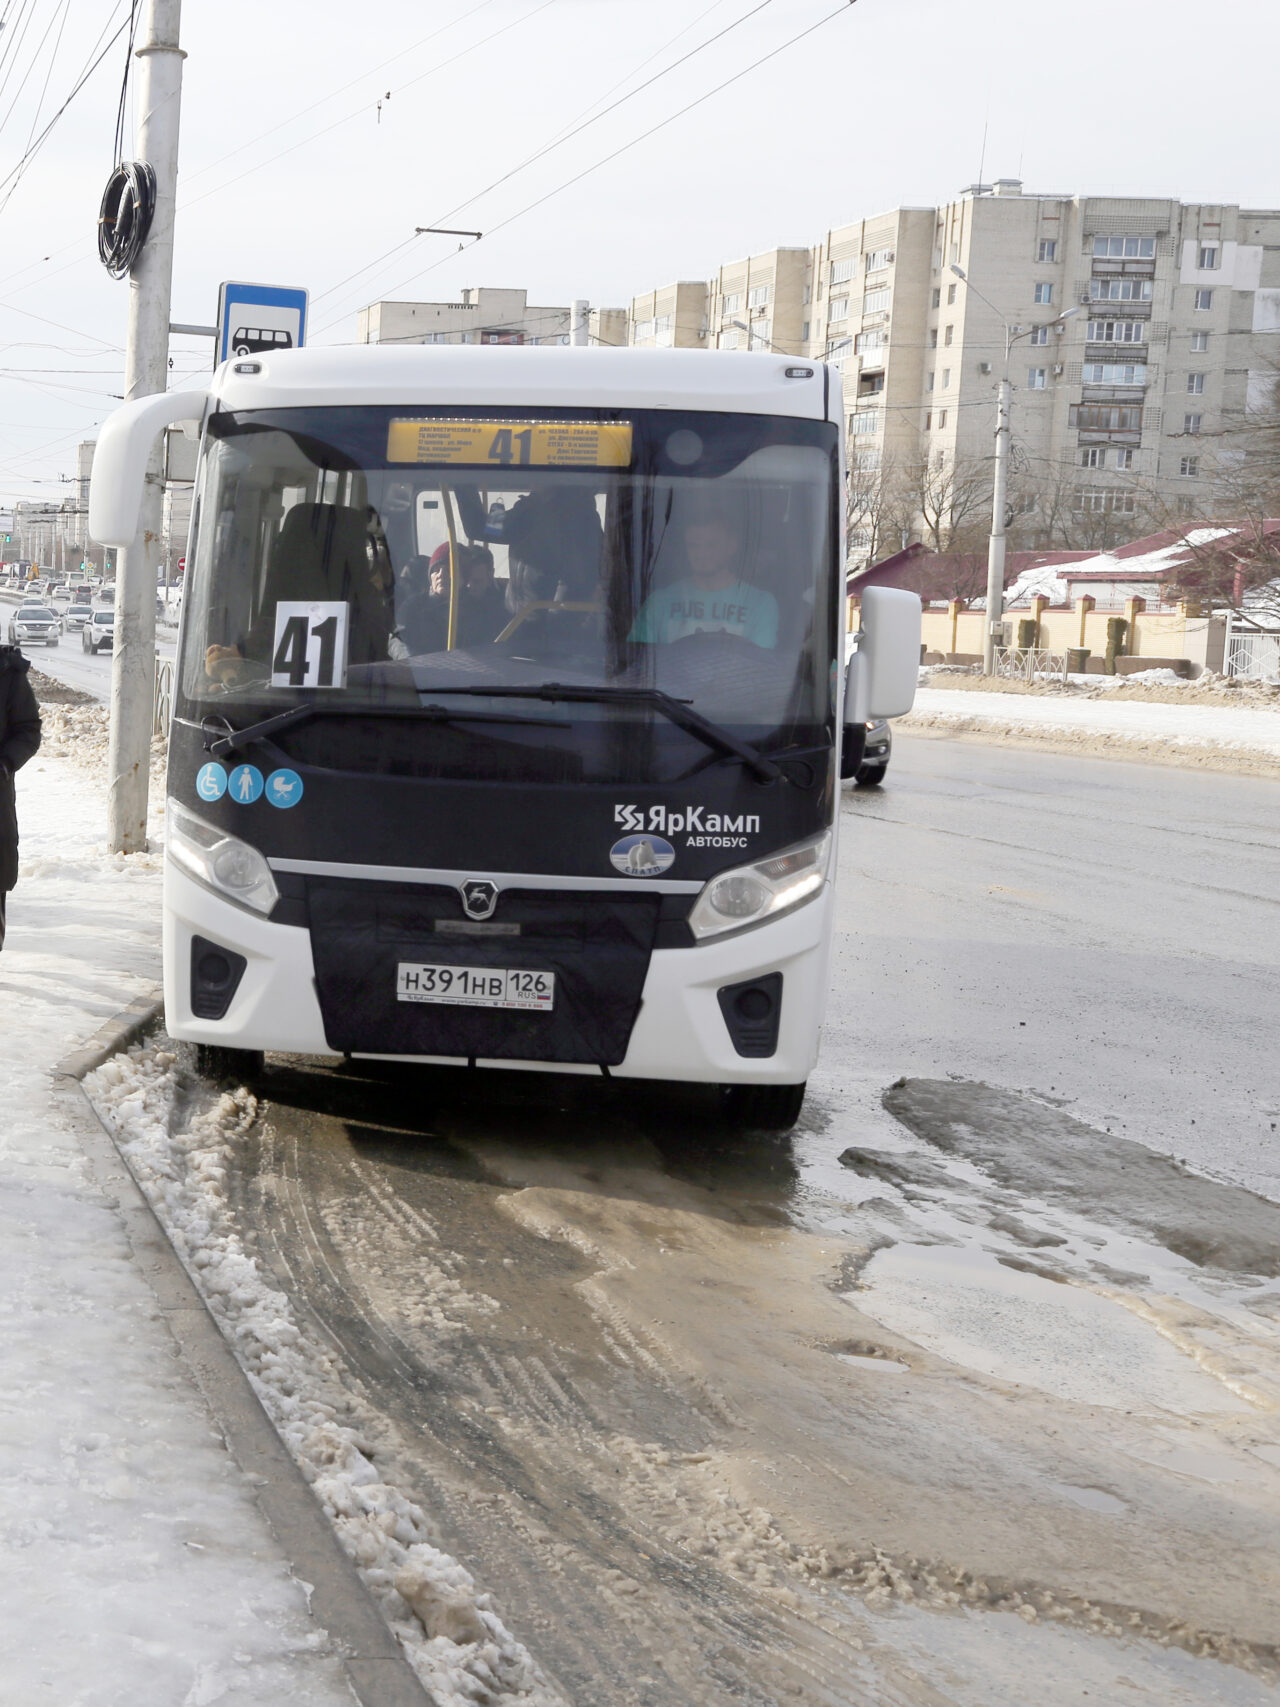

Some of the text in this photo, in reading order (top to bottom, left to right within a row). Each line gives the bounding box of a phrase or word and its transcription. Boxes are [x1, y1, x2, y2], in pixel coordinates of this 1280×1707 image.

[487, 428, 533, 465] 41
[670, 601, 748, 623] PUG LIFE
[273, 616, 338, 686] 41
[647, 805, 760, 836] ЯрКамп
[686, 836, 748, 848] АВТОБУС
[405, 967, 547, 996] Н391НВ 126
[517, 991, 537, 1000] RUS
